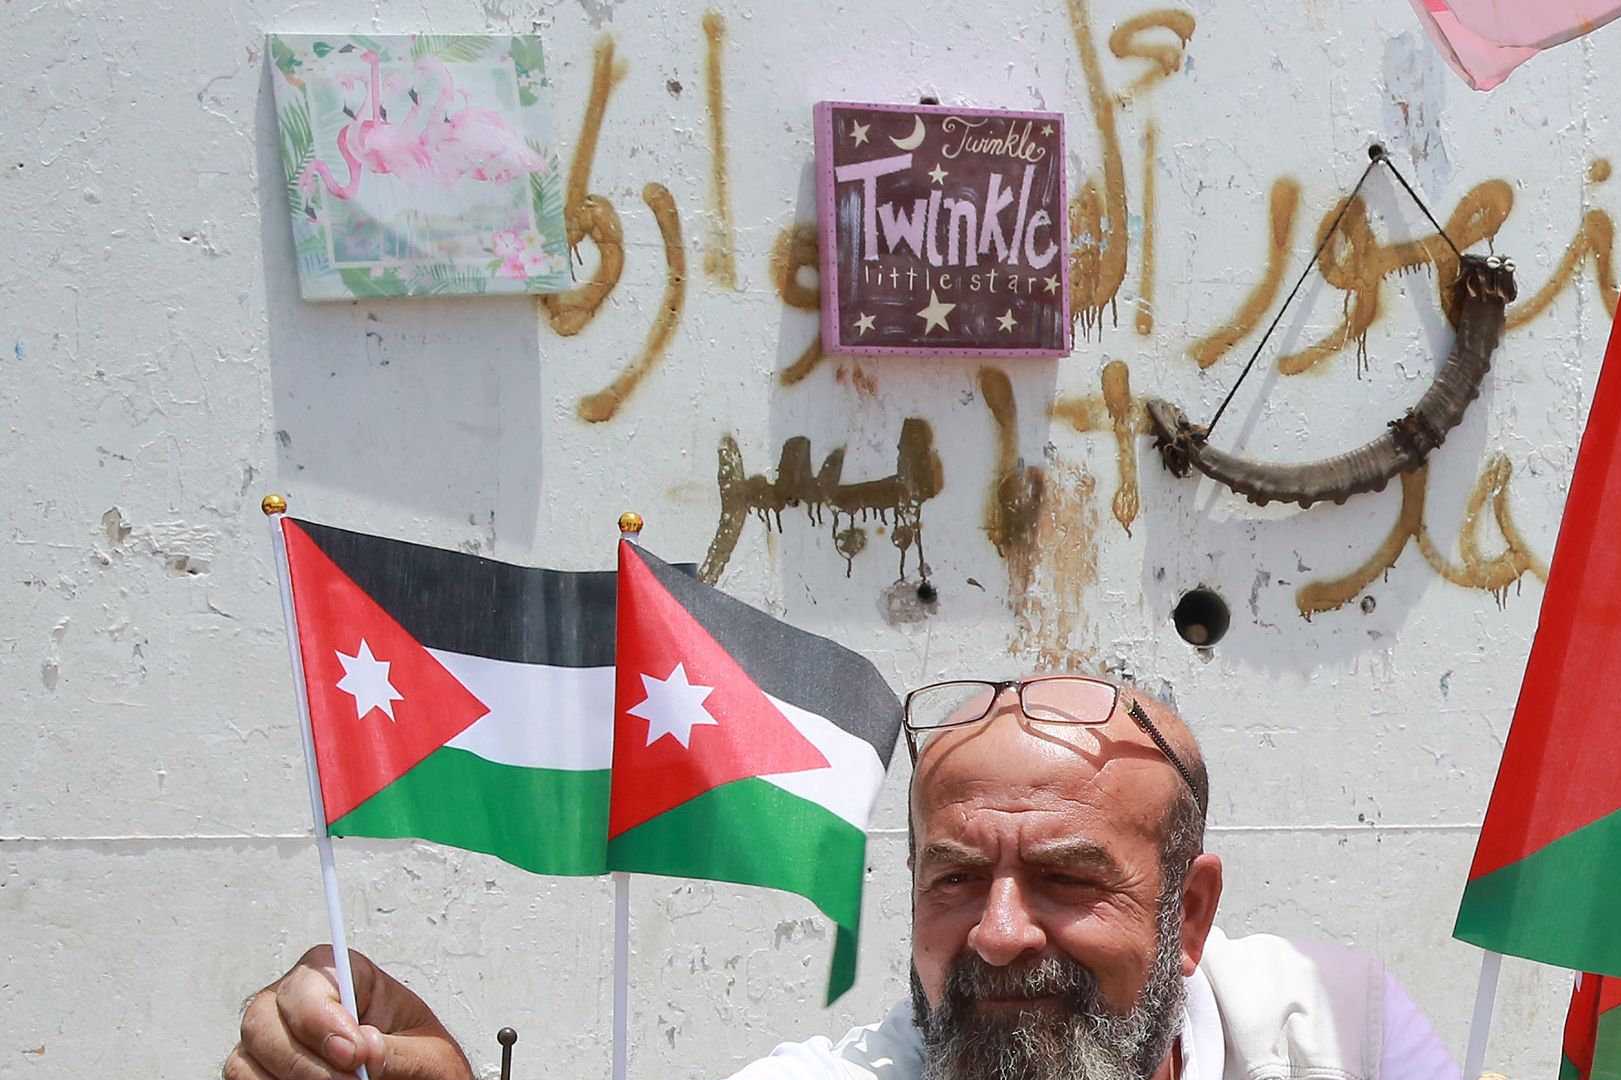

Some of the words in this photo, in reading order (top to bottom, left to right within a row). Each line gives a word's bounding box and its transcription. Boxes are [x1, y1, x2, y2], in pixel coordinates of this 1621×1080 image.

[942, 116, 1046, 162] Twinkle
[835, 153, 1059, 269] Twinkle
[864, 265, 952, 290] little
[970, 267, 1037, 294] star
